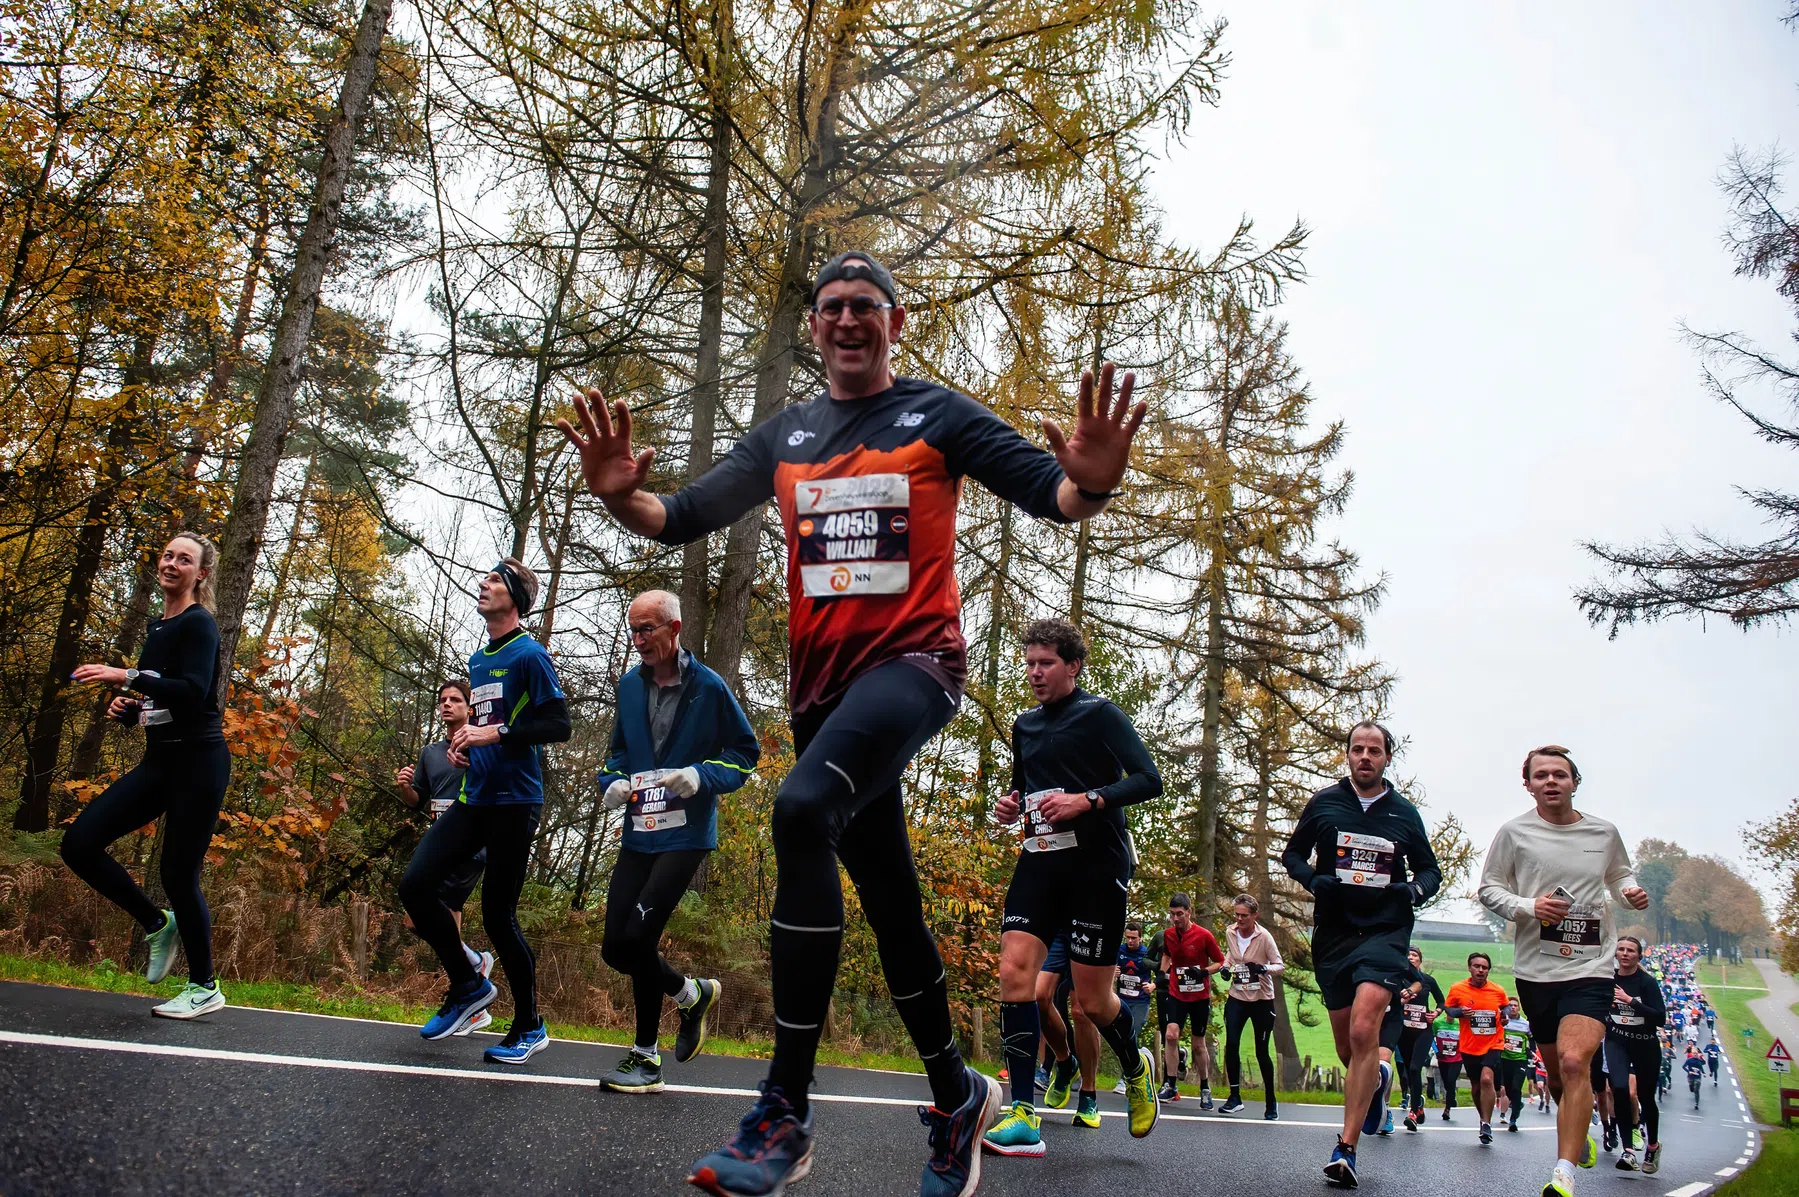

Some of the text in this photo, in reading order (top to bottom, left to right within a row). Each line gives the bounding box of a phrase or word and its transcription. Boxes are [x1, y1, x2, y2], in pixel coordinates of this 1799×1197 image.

[808, 488, 823, 507] 7
[822, 510, 879, 538] 4059
[826, 539, 878, 560] WILLIAM
[855, 573, 871, 582] NN
[635, 776, 643, 787] 7
[644, 787, 666, 802] 1787
[1035, 824, 1053, 835] CHRIS
[1344, 835, 1351, 844] 7
[1351, 849, 1378, 862] 9247
[1351, 861, 1376, 871] MARCEL
[1556, 920, 1587, 933] 2052
[1562, 933, 1581, 943] KEES
[1611, 1026, 1655, 1040] PINKSODA
